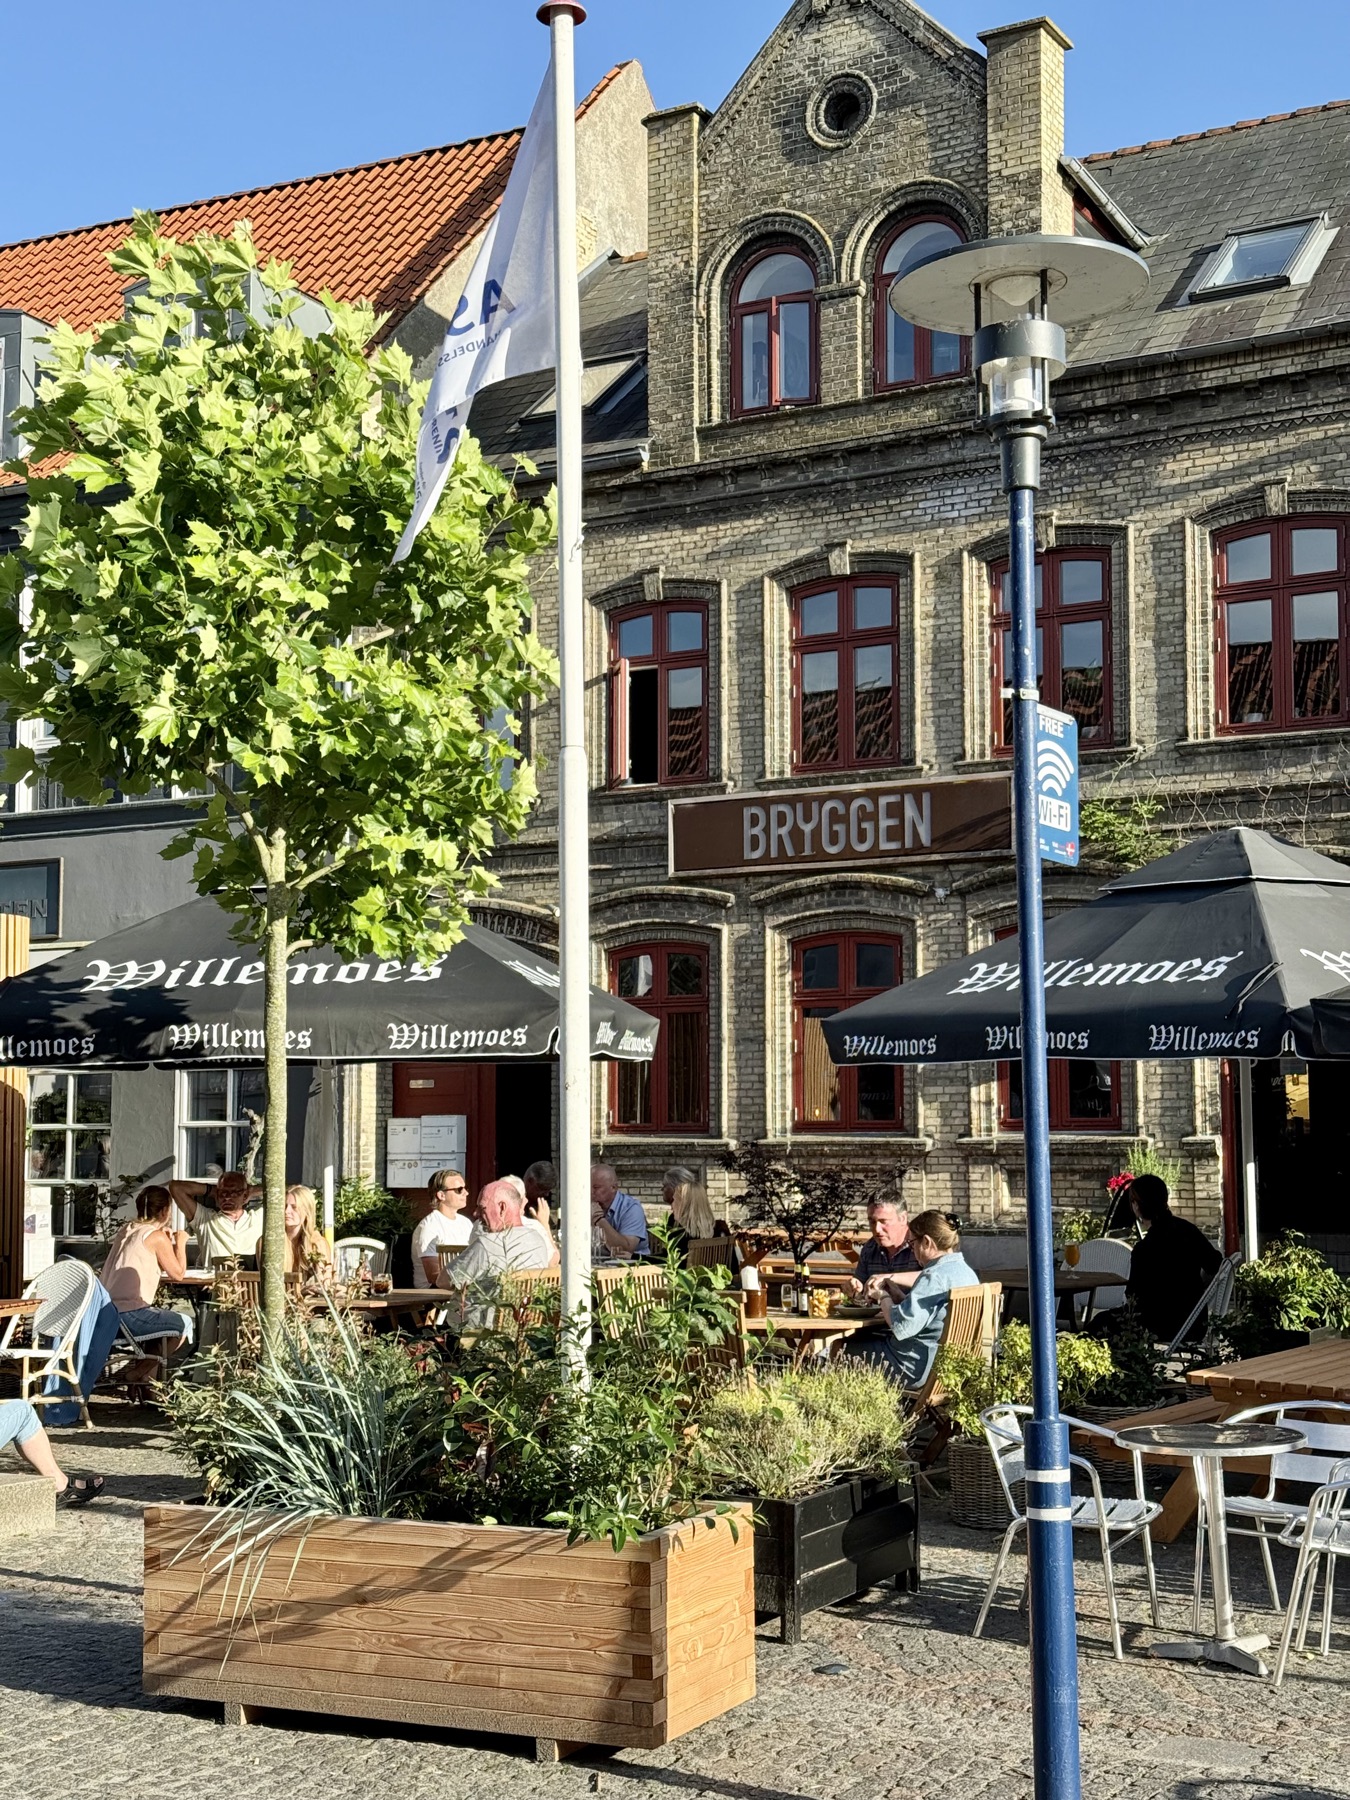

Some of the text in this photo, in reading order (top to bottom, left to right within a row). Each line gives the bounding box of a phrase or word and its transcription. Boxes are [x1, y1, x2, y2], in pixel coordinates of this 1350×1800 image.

[1039, 714, 1065, 739] FREE
[743, 791, 932, 861] BRYGGEN
[1039, 799, 1068, 829] Wi-Fi
[80, 954, 448, 993] Willemoes
[168, 1022, 313, 1051] Willemes
[387, 1023, 529, 1051] Willemoes
[843, 1034, 938, 1058] Willemoes
[984, 1025, 1091, 1052] Wilmoes
